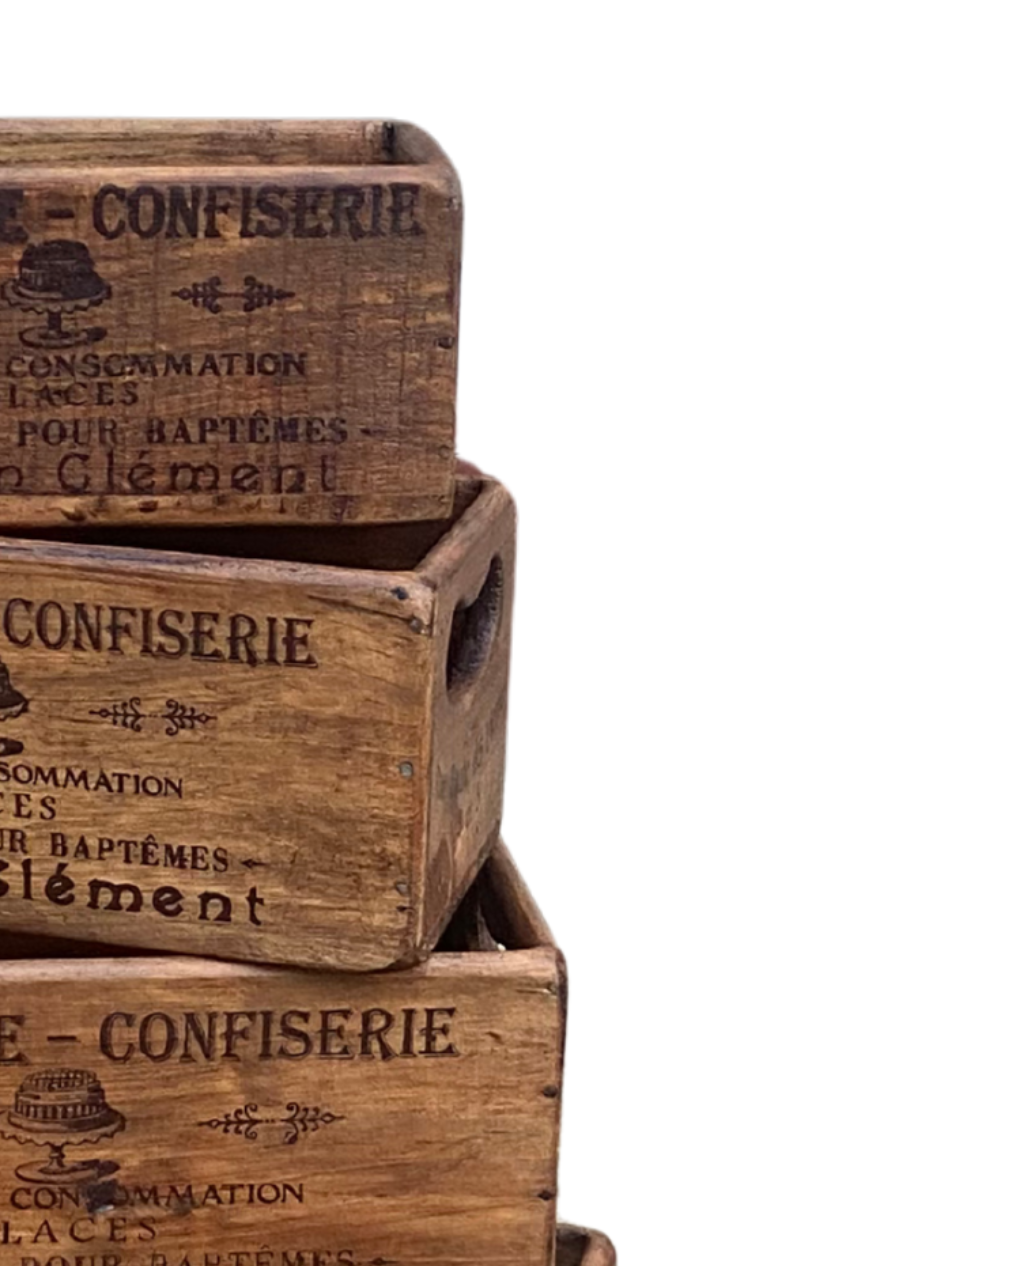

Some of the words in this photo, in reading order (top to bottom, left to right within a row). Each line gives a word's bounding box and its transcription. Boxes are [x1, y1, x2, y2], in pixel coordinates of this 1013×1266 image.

[91, 182, 425, 240] CONFISERIE
[15, 417, 117, 446] POUR
[58, 450, 337, 494] Clément
[3, 597, 318, 669] CONFISERIE
[50, 830, 229, 873] BAPTÊMES
[99, 1007, 458, 1062] CONFISERIE
[10, 1182, 305, 1214] CONOMMATION
